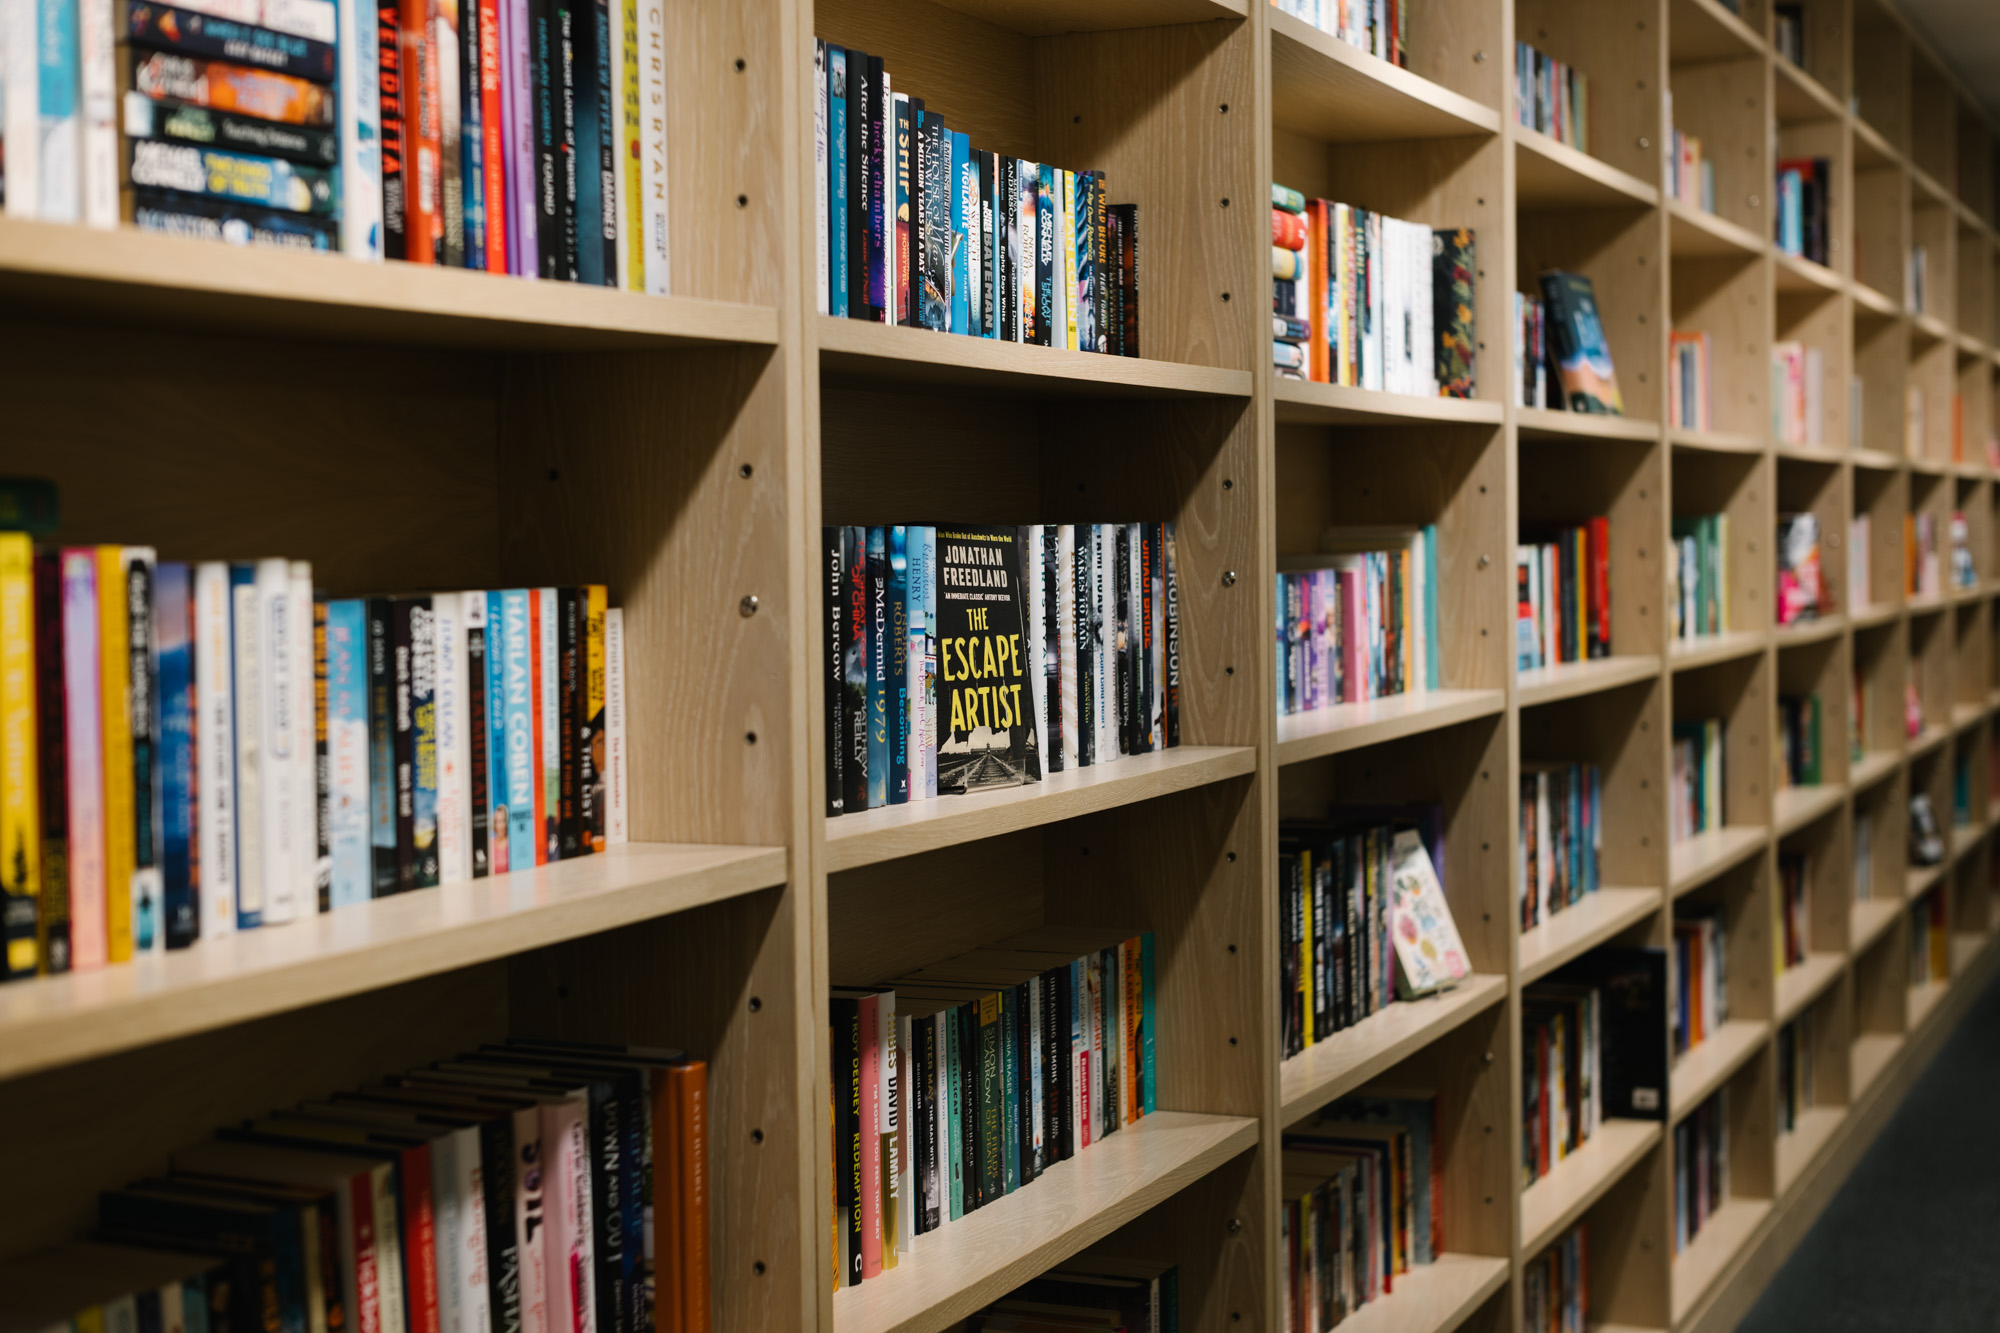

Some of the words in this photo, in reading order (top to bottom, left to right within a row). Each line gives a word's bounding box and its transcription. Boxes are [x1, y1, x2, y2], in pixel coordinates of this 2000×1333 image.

[597, 12, 610, 85] ANDREW
[650, 8, 662, 105] CHRIS
[378, 8, 402, 175] VENDETTA
[861, 75, 869, 120] After
[599, 90, 612, 147] PYPER
[836, 128, 846, 160] Night
[861, 123, 869, 150] the
[872, 120, 883, 164] becky
[917, 131, 925, 140] A
[543, 153, 556, 216] FOUND
[652, 117, 665, 201] RYAN
[861, 154, 869, 211] Silence
[898, 133, 910, 197] SHIP
[932, 153, 940, 204] HOUSE
[601, 171, 616, 240] DAMNED
[874, 170, 883, 248] chambers
[925, 168, 933, 236] WITNESS
[933, 206, 940, 223] OF
[1066, 175, 1075, 252] HARLAN
[1098, 193, 1106, 223] WILD
[918, 226, 925, 240] IN
[918, 242, 925, 250] A
[931, 225, 945, 266] War
[1098, 225, 1107, 264] BEFORE
[984, 233, 993, 329] BATEMAN
[1068, 258, 1076, 322] COBEN
[831, 549, 841, 597] John
[851, 565, 860, 587] OF
[858, 540, 866, 568] THE
[912, 558, 921, 602] HENRY
[943, 567, 1008, 588] FREEDLAND
[945, 545, 1003, 566] JONATHAN
[1078, 545, 1086, 593] WAKES
[1142, 540, 1151, 594] JIHADI
[852, 589, 861, 641] CHINA
[859, 574, 867, 627] GREAT
[951, 592, 969, 600] IMMEDIATE
[998, 594, 1011, 602] BEEVOR
[966, 607, 989, 631] THE
[1079, 598, 1086, 616] TO
[506, 595, 527, 704] HARLAN
[610, 621, 621, 675] STEPHEN
[831, 605, 842, 682] Bercow
[875, 587, 885, 682] McDermid
[893, 601, 903, 677] ROBERTS
[1079, 618, 1087, 651] RAIN
[1143, 597, 1152, 651] BRIDE
[1168, 572, 1179, 688] ROBINSON
[941, 634, 1023, 681] ESCAPE
[611, 677, 622, 728] LEATHER
[874, 689, 886, 744] 1979
[896, 687, 907, 765] Becoming
[950, 684, 1021, 732] ARTIST
[511, 711, 530, 805] COBEN
[581, 726, 592, 740] &
[854, 711, 862, 764] REILLY
[582, 746, 592, 780] THE
[582, 784, 593, 819] LIST
[852, 1013, 860, 1053] TROY
[888, 1011, 897, 1070] TRIBES
[1094, 980, 1102, 1053] SLINGSHOT
[692, 1091, 703, 1133] KATE
[852, 1057, 861, 1117] DEENEY
[888, 1076, 898, 1128] DAVID
[603, 1102, 620, 1172] DOWN
[986, 1109, 992, 1127] OF
[853, 1132, 862, 1233] REDEMPTION
[889, 1136, 898, 1199] LAMMY
[930, 1170, 935, 1182] NO
[605, 1211, 622, 1264] OUT
